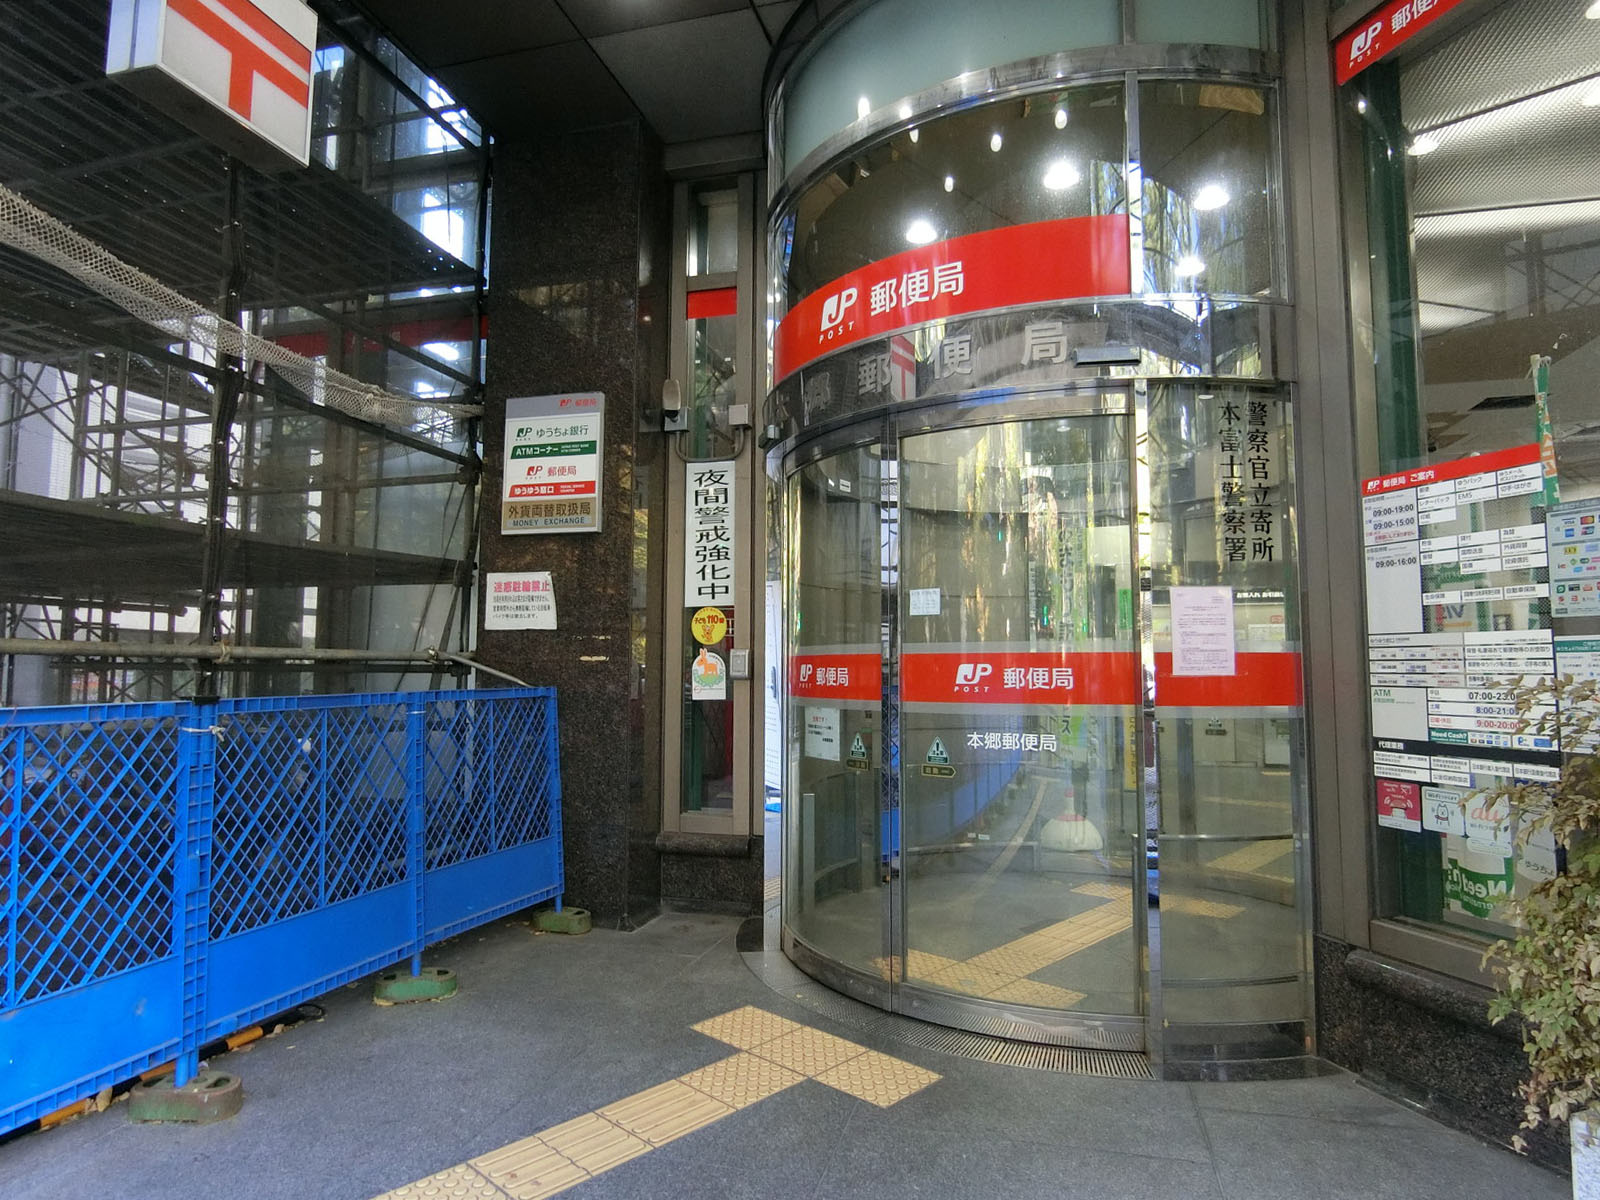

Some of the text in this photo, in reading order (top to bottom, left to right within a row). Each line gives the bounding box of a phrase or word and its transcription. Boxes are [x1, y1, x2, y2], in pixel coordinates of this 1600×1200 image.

[1391, 0, 1438, 35] 郵便
[1349, 42, 1381, 69] POST
[870, 261, 965, 317] 郵便局
[819, 322, 854, 345] POST
[536, 424, 589, 438] ゆうちょ銀行
[515, 445, 559, 456] ATMコーナー
[547, 465, 577, 477] 郵便局
[1218, 401, 1248, 563] 本富士警察署
[1246, 401, 1275, 563] 警察官立寄所
[1457, 477, 1483, 486] ゆうパック
[514, 485, 555, 495] ゆうゆう窓口
[1419, 497, 1450, 506] レターパック
[509, 501, 591, 519] 外貨両替取扱局
[1373, 503, 1414, 518] 09:00-19:00
[513, 516, 585, 527] MONEY EXCHANGE
[1373, 517, 1415, 531] 09:00-15:00
[693, 469, 731, 600] 夜間警戒強化中
[1375, 556, 1418, 569] 09:00-16:00
[816, 666, 849, 687] 郵便局
[1003, 667, 1074, 690] 郵便局
[1373, 688, 1391, 697] ATM
[1468, 691, 1516, 701] 07:00-23:0
[1475, 706, 1518, 715] 8:00-21:0
[1476, 719, 1521, 730] 9:00-20:00
[967, 731, 1057, 752] 本郷郵便局
[1448, 731, 1467, 739] Cash?
